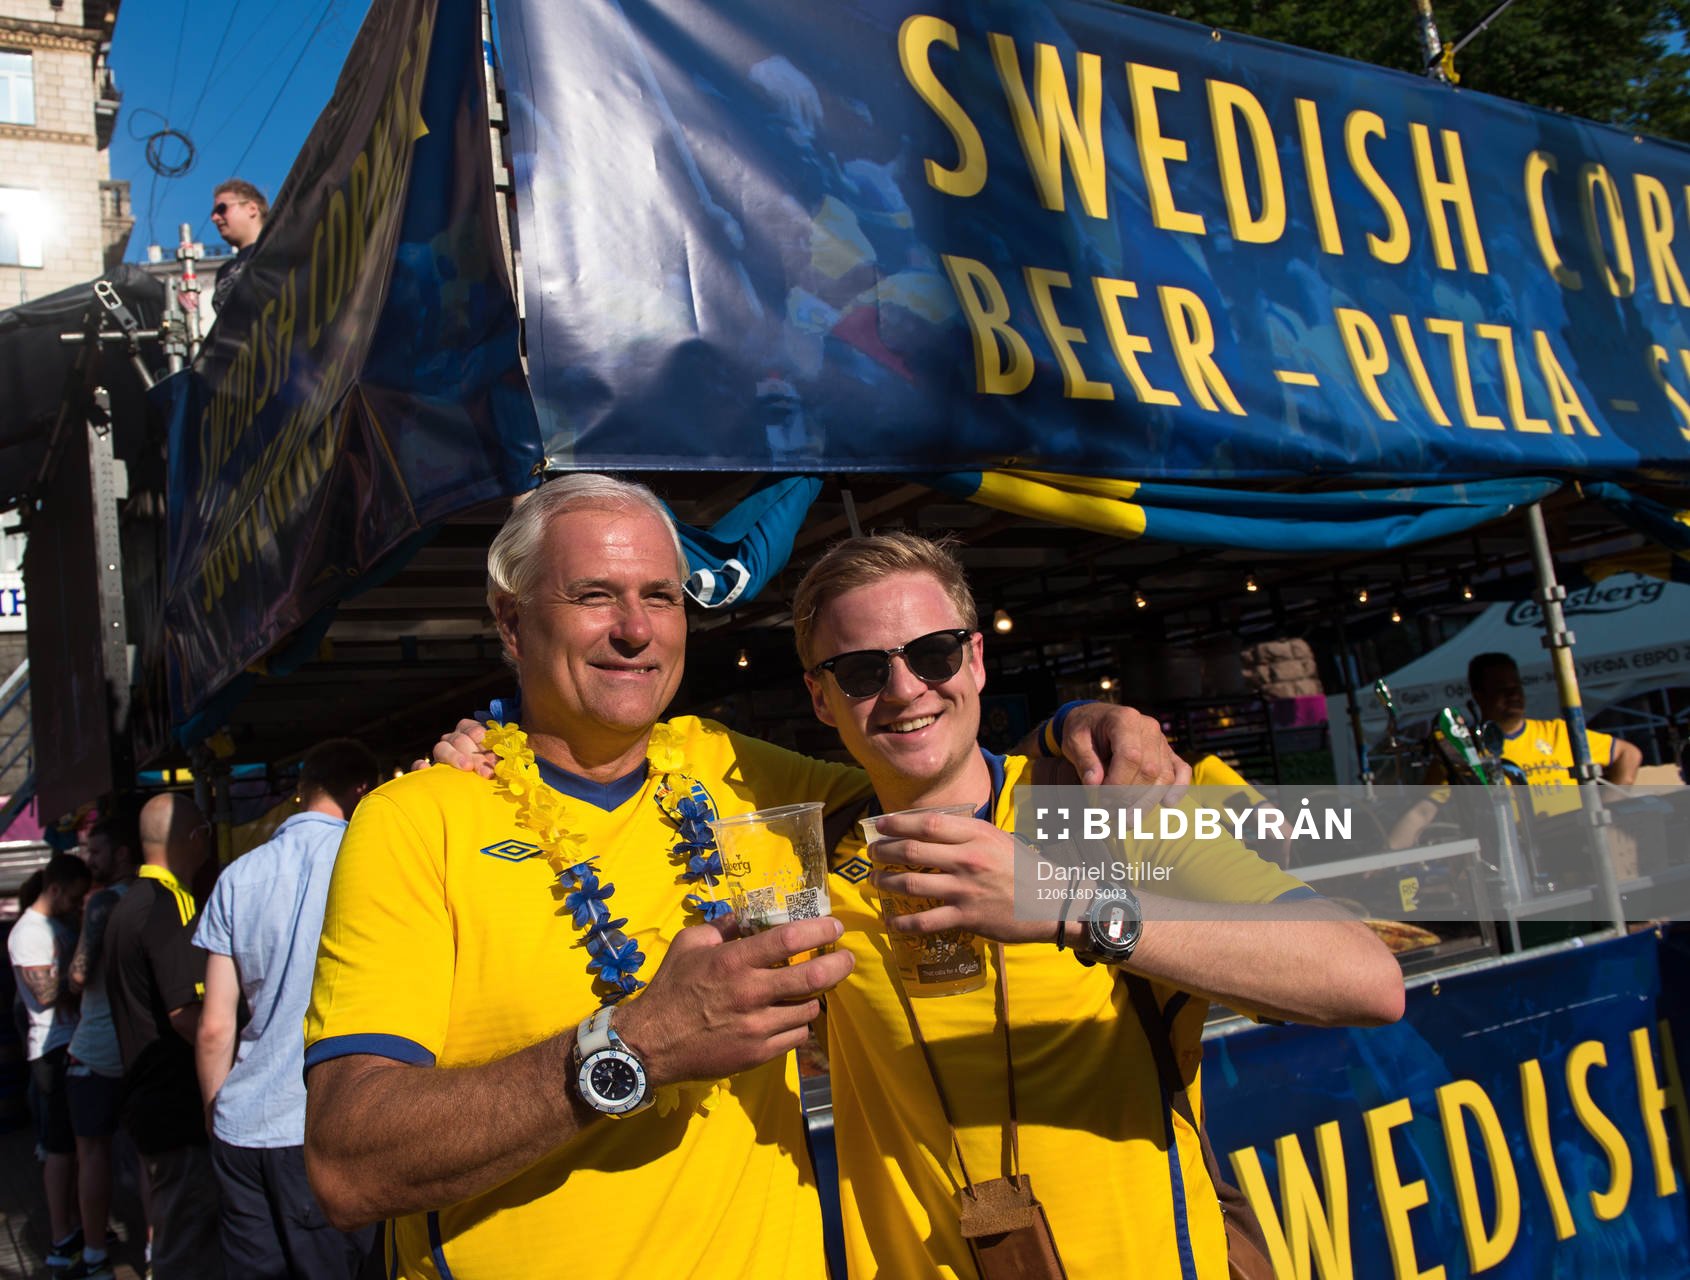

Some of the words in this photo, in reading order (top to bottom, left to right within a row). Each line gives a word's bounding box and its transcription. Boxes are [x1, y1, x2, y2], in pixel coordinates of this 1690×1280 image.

[898, 14, 1490, 275] SWEDISH
[1524, 149, 1690, 308] COR
[941, 254, 1248, 417] BEER
[1336, 308, 1601, 437] PIZZA
[1646, 343, 1690, 442] S
[1505, 579, 1667, 628] Casberg
